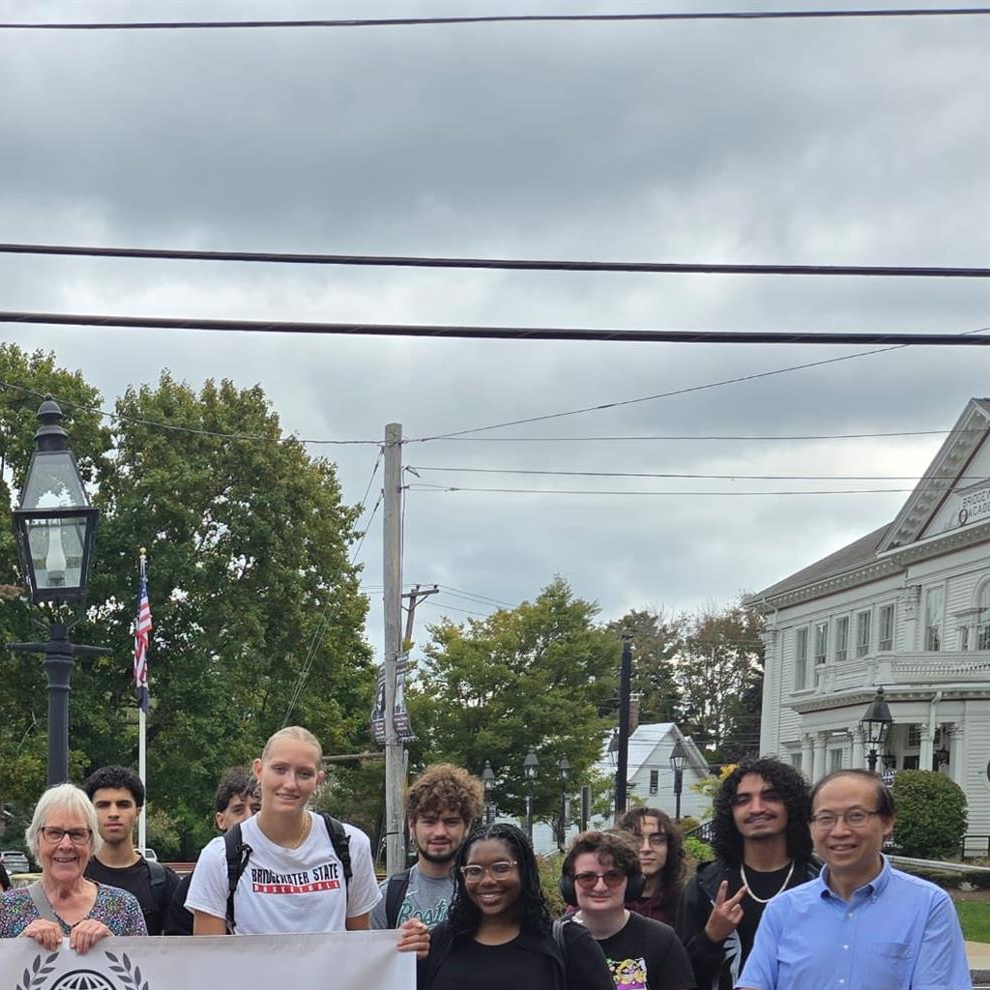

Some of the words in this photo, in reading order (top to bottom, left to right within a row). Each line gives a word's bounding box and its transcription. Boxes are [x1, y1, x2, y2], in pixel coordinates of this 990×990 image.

[251, 868, 310, 886] BRIDGEWATER
[312, 863, 339, 881] STATE
[254, 881, 339, 893] BASKETBALL
